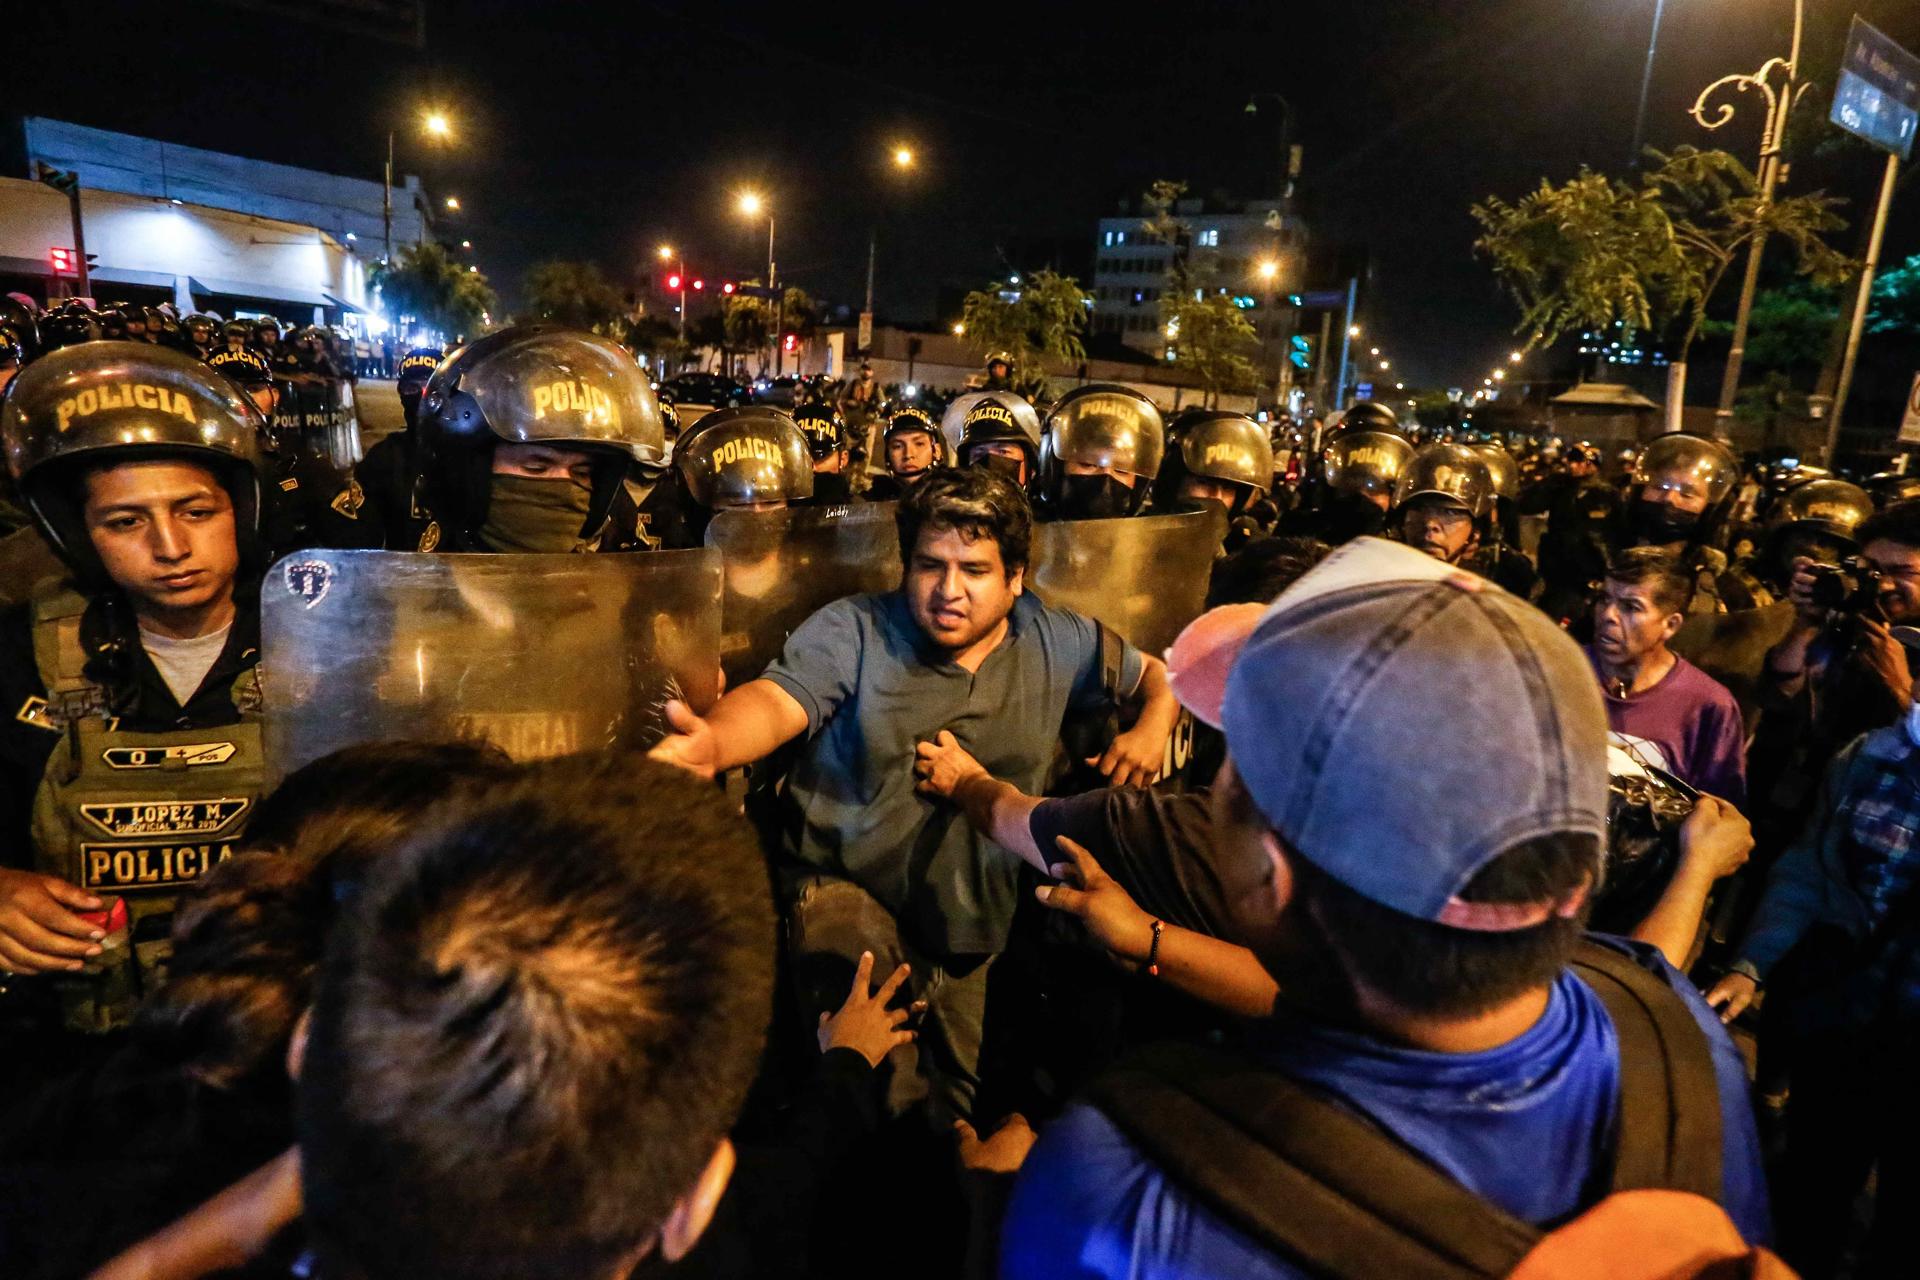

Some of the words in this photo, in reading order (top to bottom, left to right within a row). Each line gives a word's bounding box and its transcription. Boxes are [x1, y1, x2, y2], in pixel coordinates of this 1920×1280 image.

[56, 383, 197, 433] POLICIA
[1078, 399, 1140, 434] POLICIA
[712, 437, 785, 474] POLICIA
[103, 807, 121, 825] J.
[131, 805, 195, 823] LOPEZ
[205, 803, 227, 820] M.
